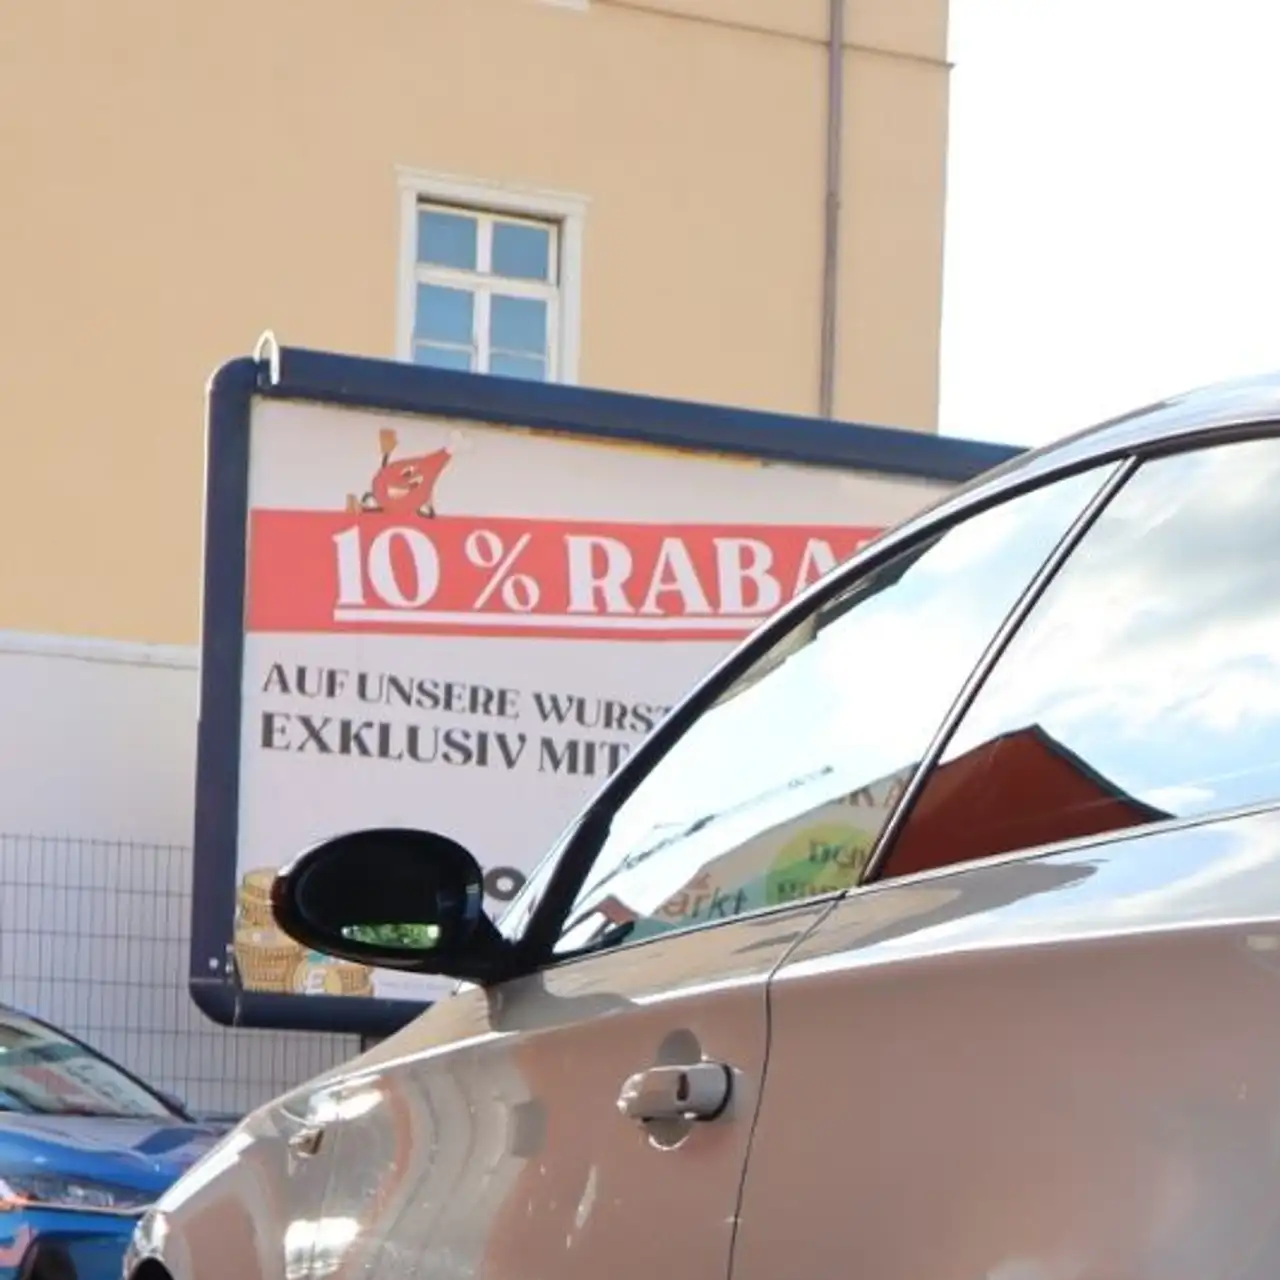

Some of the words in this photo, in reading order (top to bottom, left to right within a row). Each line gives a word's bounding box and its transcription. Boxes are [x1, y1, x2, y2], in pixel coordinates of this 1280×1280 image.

[333, 525, 440, 609] 10
[464, 529, 540, 612] %
[565, 533, 866, 615] RABA
[261, 661, 349, 698] AUF
[357, 671, 520, 720] UNSERE
[260, 711, 528, 770] EXKLUSIV
[538, 736, 630, 777] MIT
